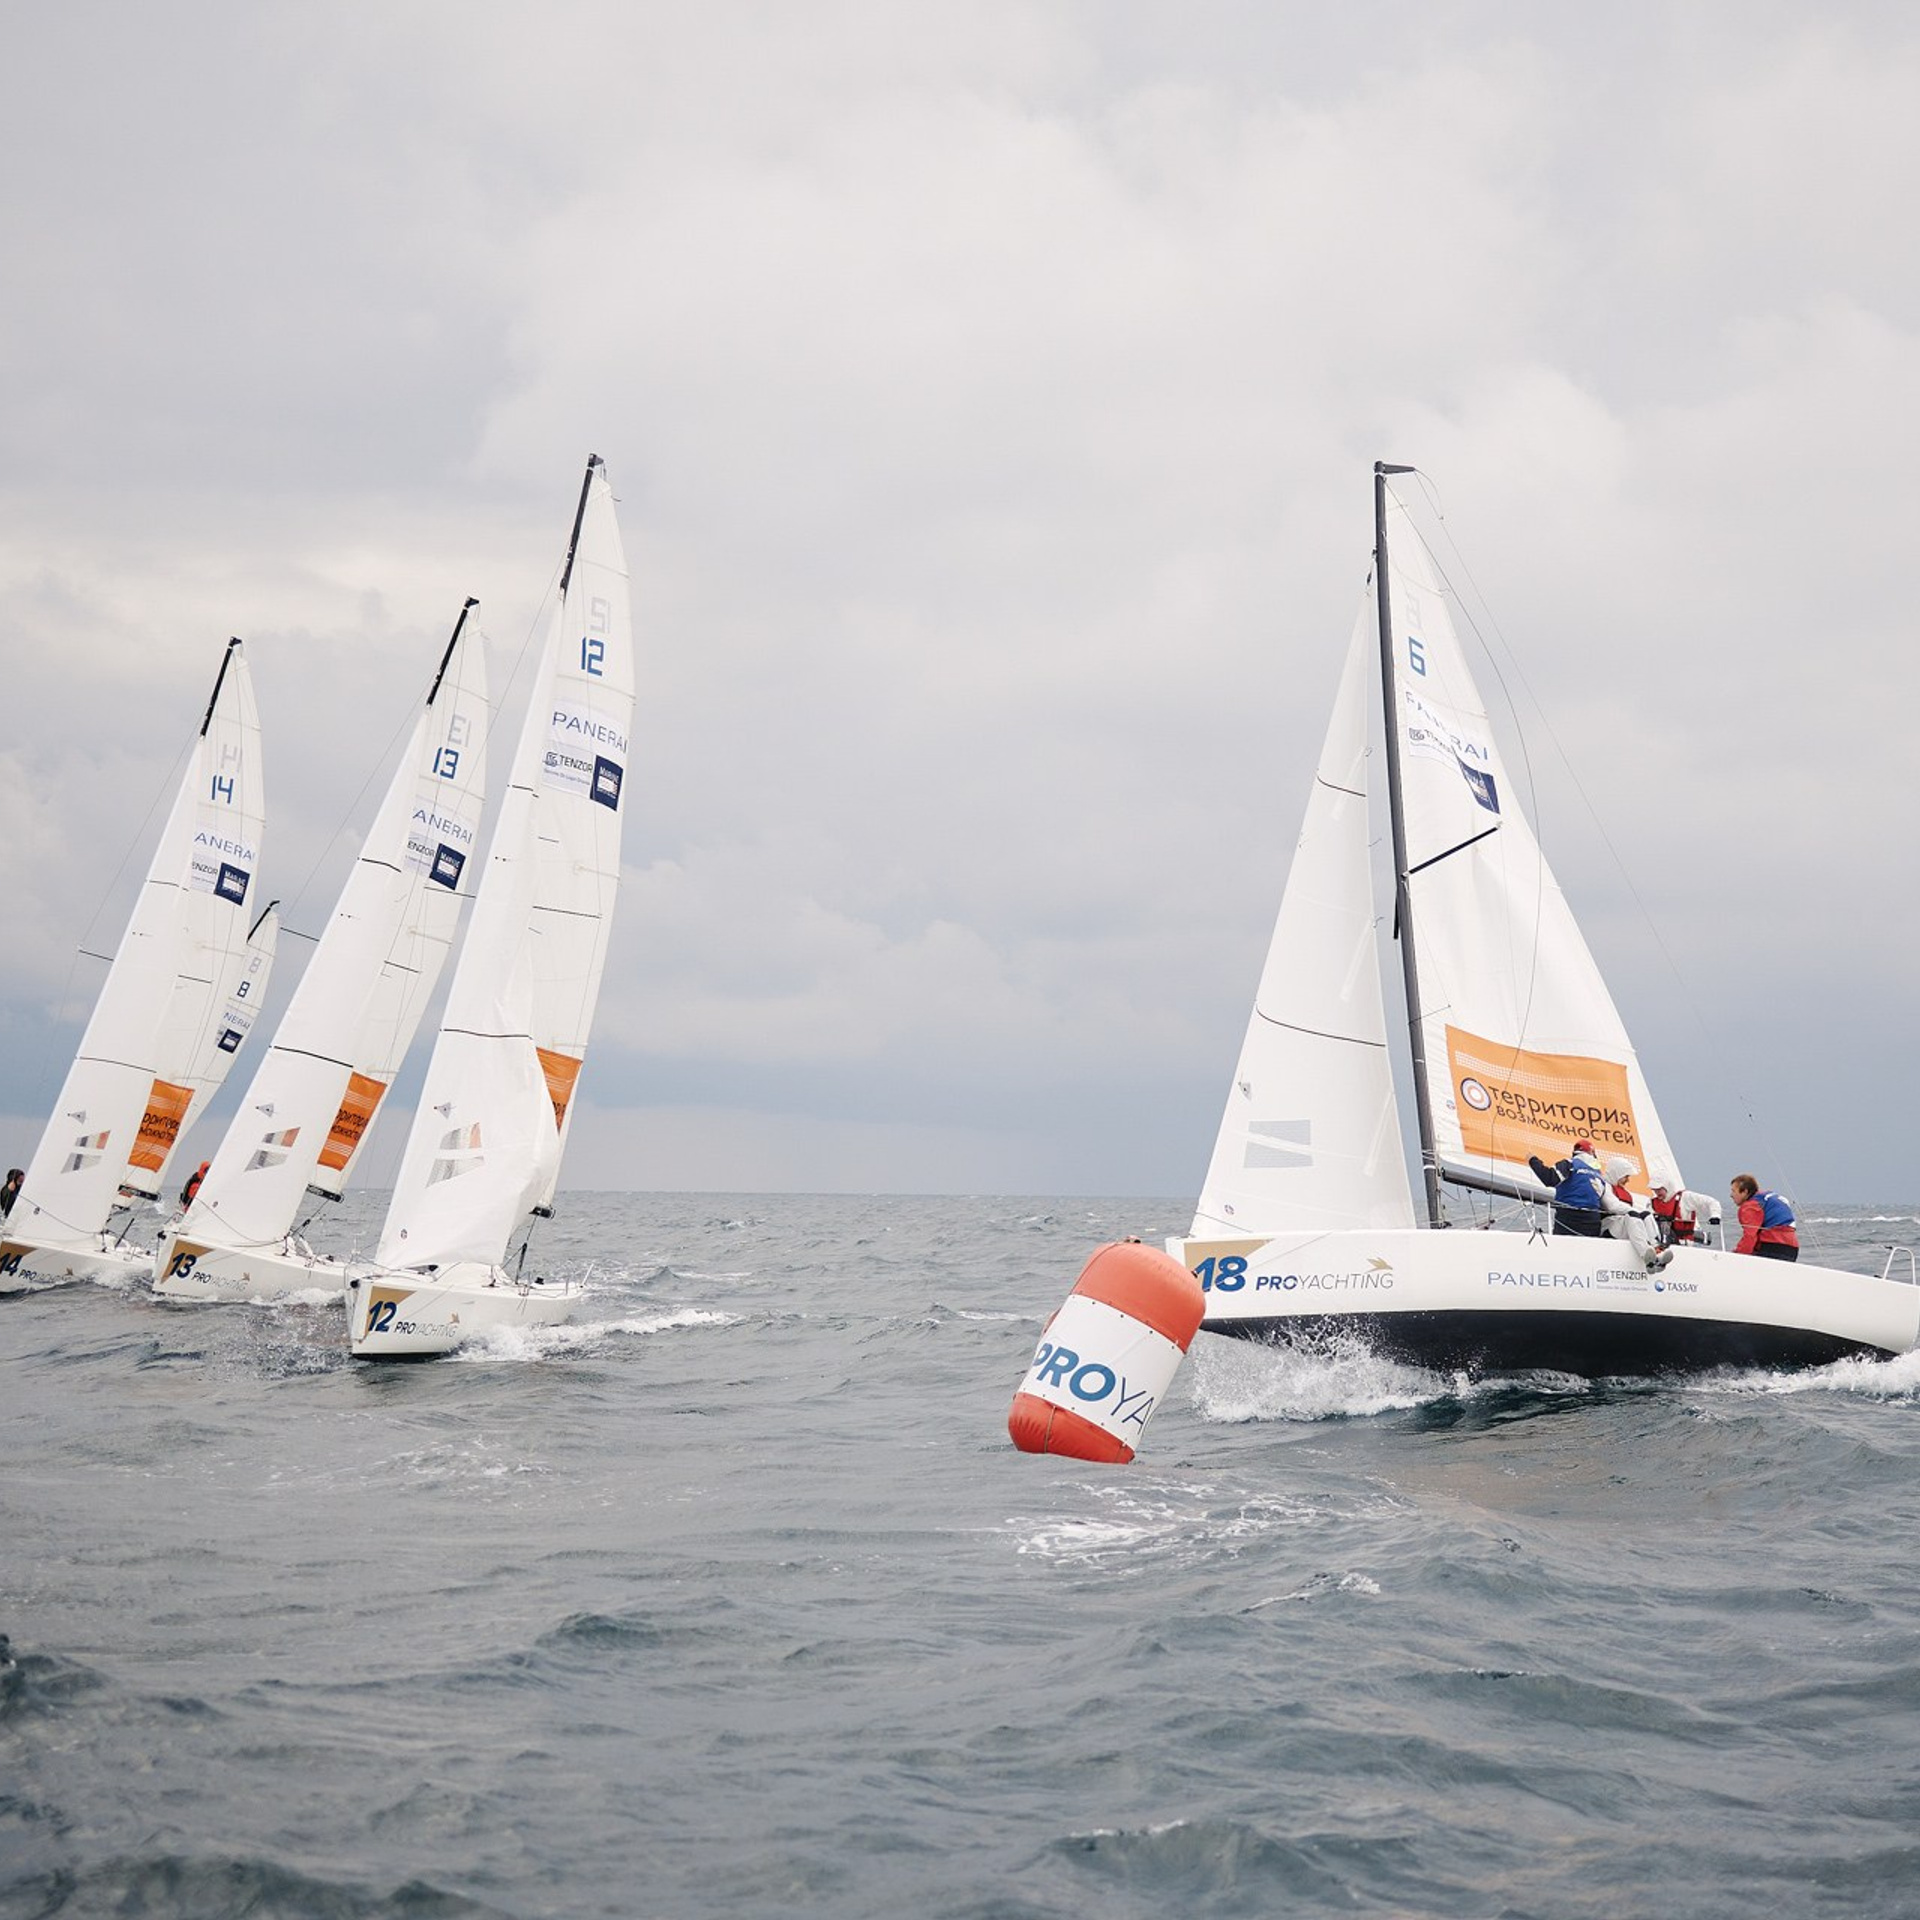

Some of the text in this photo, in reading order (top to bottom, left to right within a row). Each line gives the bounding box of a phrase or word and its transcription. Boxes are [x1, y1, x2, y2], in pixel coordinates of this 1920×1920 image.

[580, 636, 605, 676] 12
[1408, 636, 1426, 677] 6
[552, 711, 627, 754] PANERAI
[432, 747, 459, 779] 13
[559, 754, 593, 773] TENZOR
[211, 774, 234, 804] 14
[413, 809, 473, 844] ANERAI
[194, 832, 254, 861] ANERA
[407, 840, 435, 857] ENZOR
[191, 861, 218, 876] ENZOR
[237, 980, 250, 998] 8
[224, 1012, 251, 1030] NERAI
[1488, 1086, 1632, 1128] территория
[1496, 1105, 1636, 1146] возможностей
[0, 1253, 23, 1276] 14
[169, 1253, 197, 1278] 13
[1193, 1256, 1248, 1292] 18
[1610, 1271, 1648, 1281] TENZOR
[1255, 1273, 1394, 1291] PROYACHTING
[1488, 1272, 1590, 1288] PANERAI
[1667, 1282, 1699, 1292] TASSAY
[368, 1300, 397, 1332] 12
[1032, 1343, 1155, 1435] PROYA
